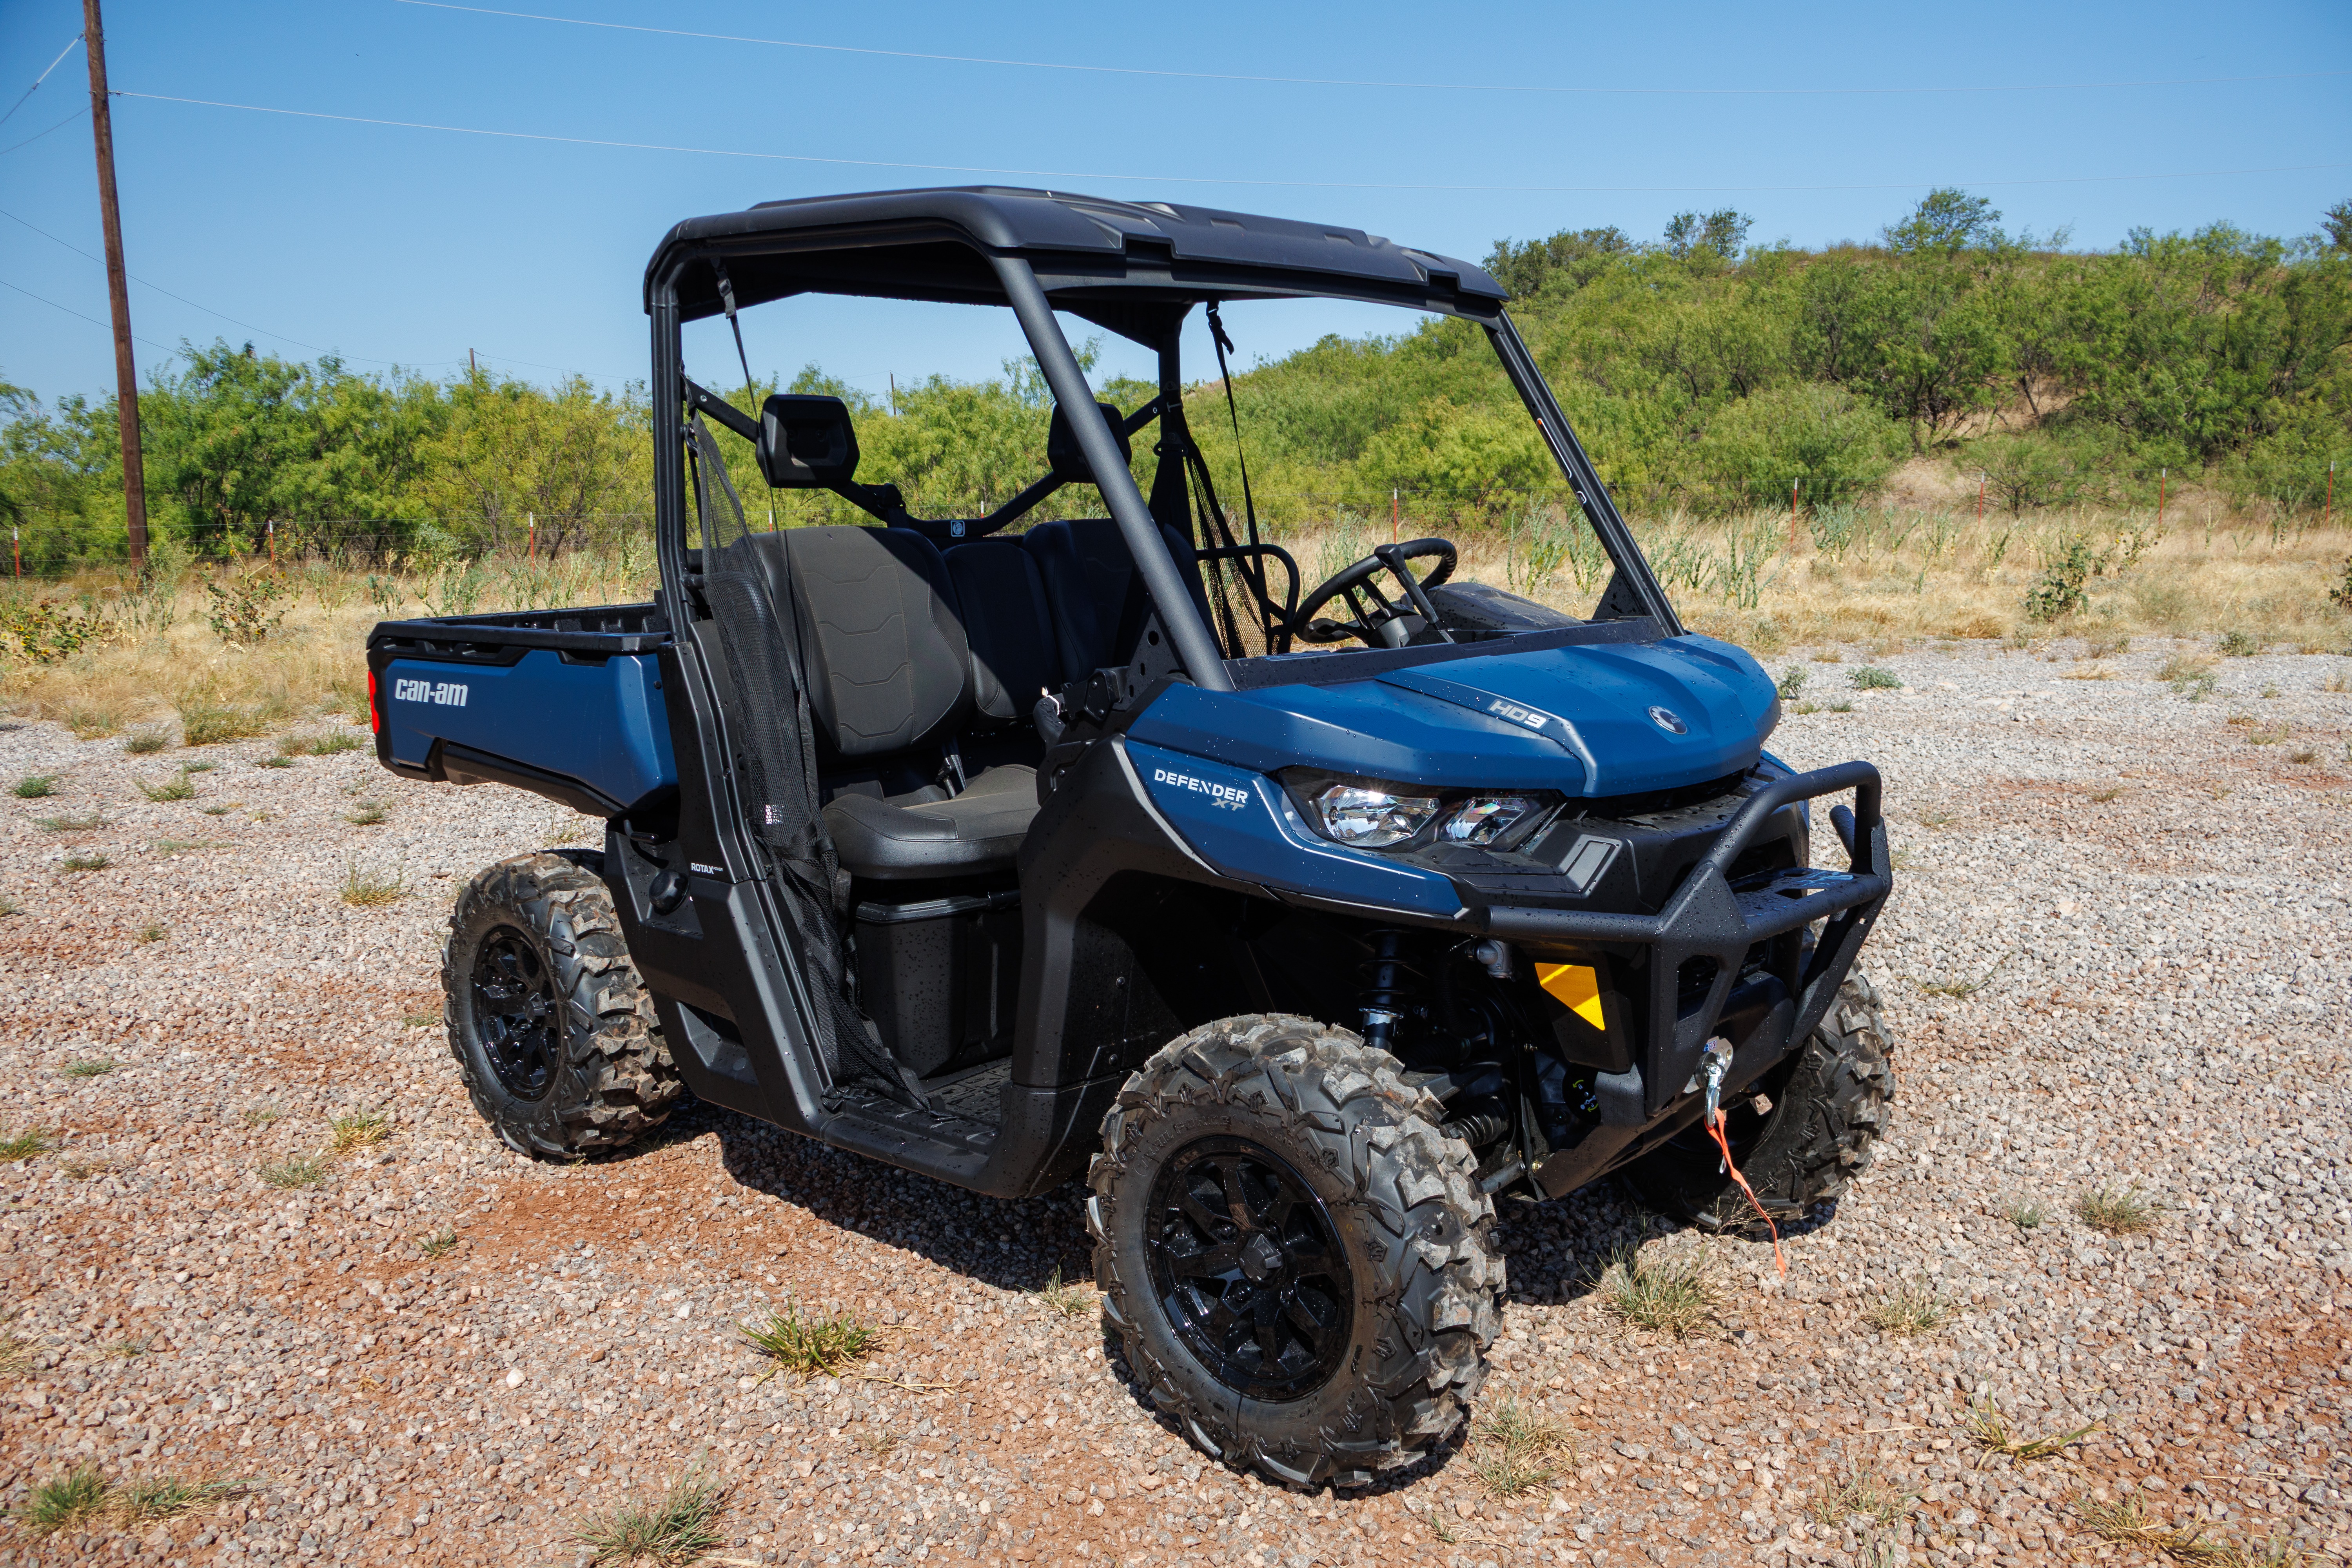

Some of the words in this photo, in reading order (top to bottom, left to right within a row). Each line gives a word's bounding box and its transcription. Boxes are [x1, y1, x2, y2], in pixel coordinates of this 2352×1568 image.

[395, 679, 468, 707] can-am
[1489, 701, 1547, 728] HD9
[1154, 769, 1248, 804] DEFENDER
[1211, 798, 1245, 811] XT
[691, 862, 714, 874] ROTAX
